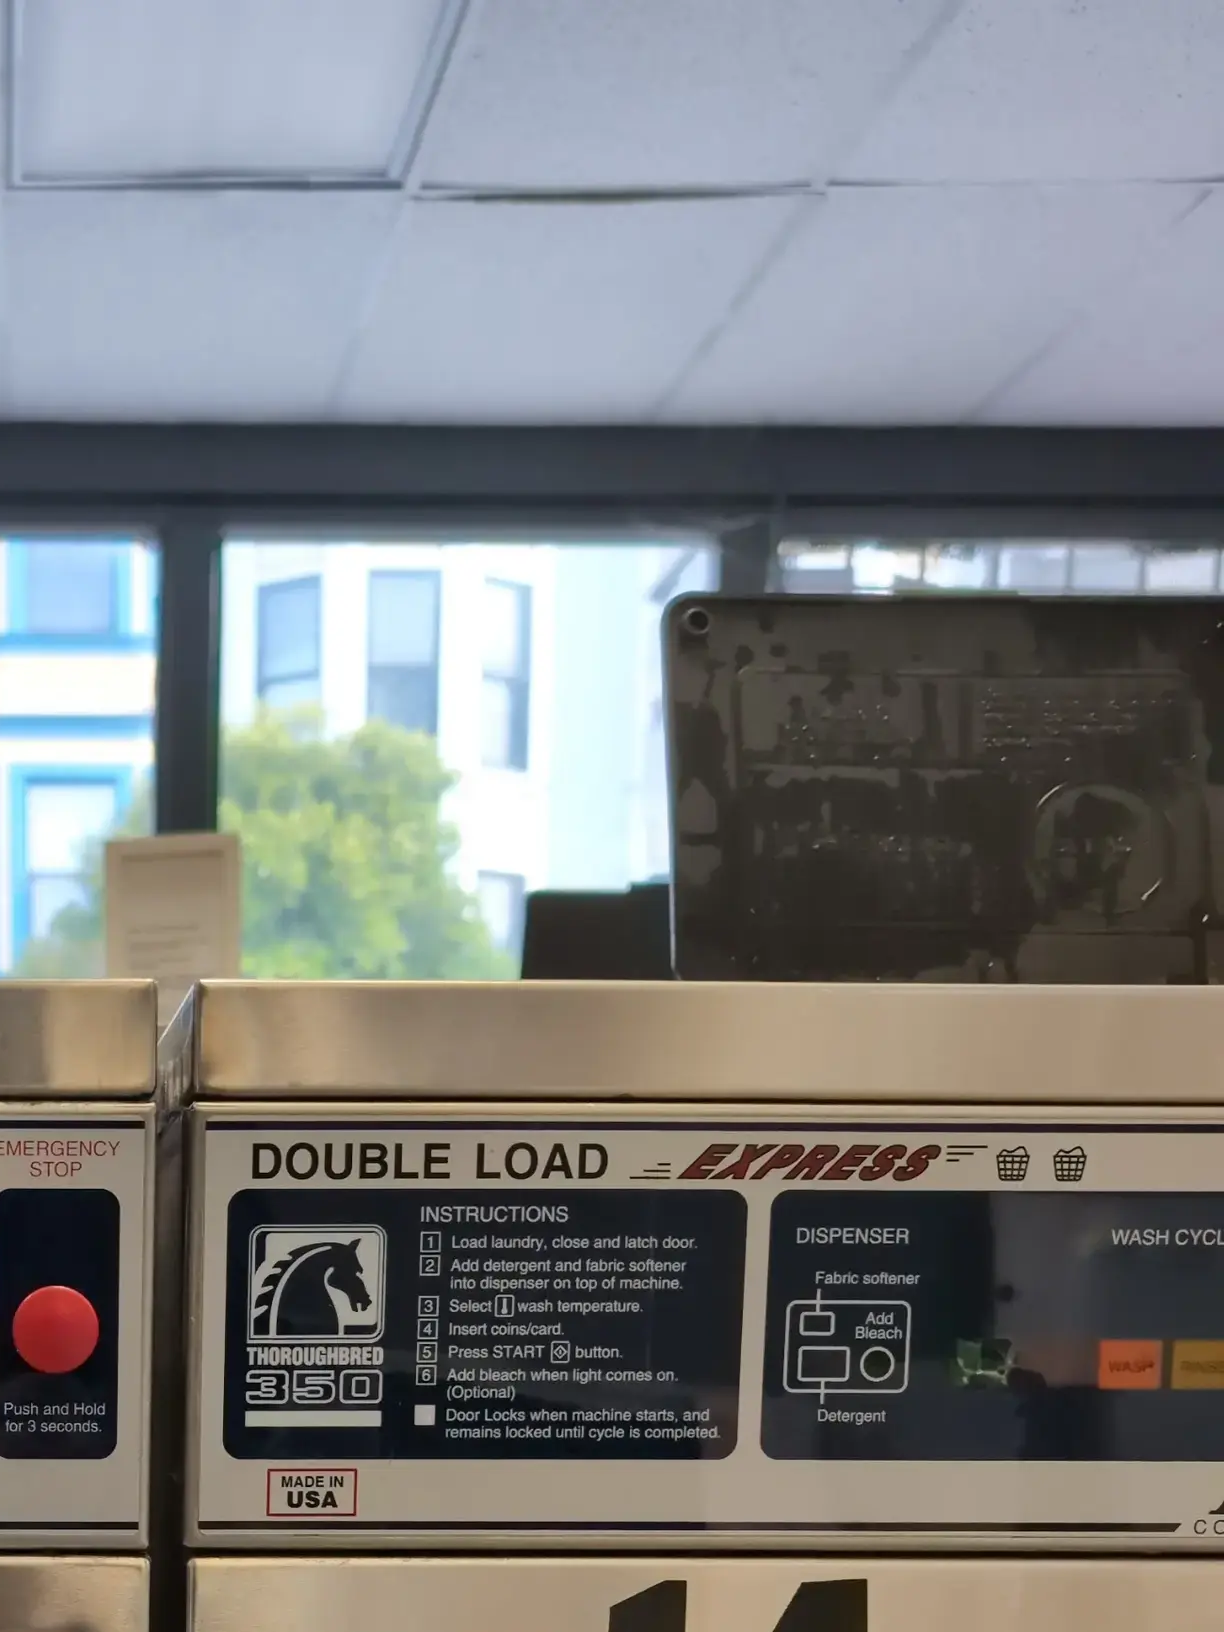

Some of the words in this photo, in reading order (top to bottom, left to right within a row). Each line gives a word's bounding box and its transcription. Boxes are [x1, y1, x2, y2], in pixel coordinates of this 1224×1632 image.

[29, 1161, 83, 1178] STOP
[251, 1142, 452, 1180] DOUBLE
[476, 1143, 609, 1180] LOAD
[677, 1144, 942, 1181] EXPRESS
[420, 1206, 569, 1223] INSTRUCTIONS
[452, 1236, 487, 1249] Load
[491, 1236, 547, 1252] laundry,
[552, 1236, 589, 1249] close
[594, 1236, 620, 1249] and
[625, 1236, 658, 1249] latch
[662, 1236, 698, 1249] door.
[796, 1228, 910, 1245] DISPENSER
[1112, 1229, 1169, 1246] WASH
[451, 1259, 479, 1272] Add
[483, 1259, 551, 1275] detergent
[555, 1259, 581, 1272] and
[585, 1259, 624, 1272] fabric
[628, 1260, 686, 1272] softener
[450, 1277, 475, 1289] into
[480, 1277, 549, 1292] dispenser
[553, 1279, 571, 1289] on
[575, 1278, 597, 1292] top
[601, 1277, 616, 1289] of
[620, 1277, 683, 1290] machine.
[815, 1271, 859, 1285] Fabric
[863, 1272, 920, 1285] softener
[449, 1300, 492, 1313] Select
[517, 1300, 553, 1313] wash
[557, 1301, 643, 1315] temperature.
[865, 1312, 893, 1325] Add
[448, 1323, 487, 1335] Insert
[491, 1323, 564, 1336] coins/card.
[855, 1326, 903, 1340] Bleach
[247, 1347, 384, 1366] THOROUGHBRED
[448, 1346, 488, 1359] Press
[492, 1346, 545, 1358] START
[575, 1346, 623, 1359] button.
[245, 1370, 383, 1405] 350
[4, 1402, 39, 1416] Push
[43, 1402, 69, 1416] and
[74, 1402, 106, 1416] Hold
[817, 1409, 886, 1425] Detergent
[5, 1420, 24, 1433] for
[27, 1420, 36, 1433] 3
[40, 1419, 103, 1433] seconds.
[281, 1475, 324, 1488] MADE
[330, 1475, 345, 1488] IN
[286, 1491, 338, 1509] USA
